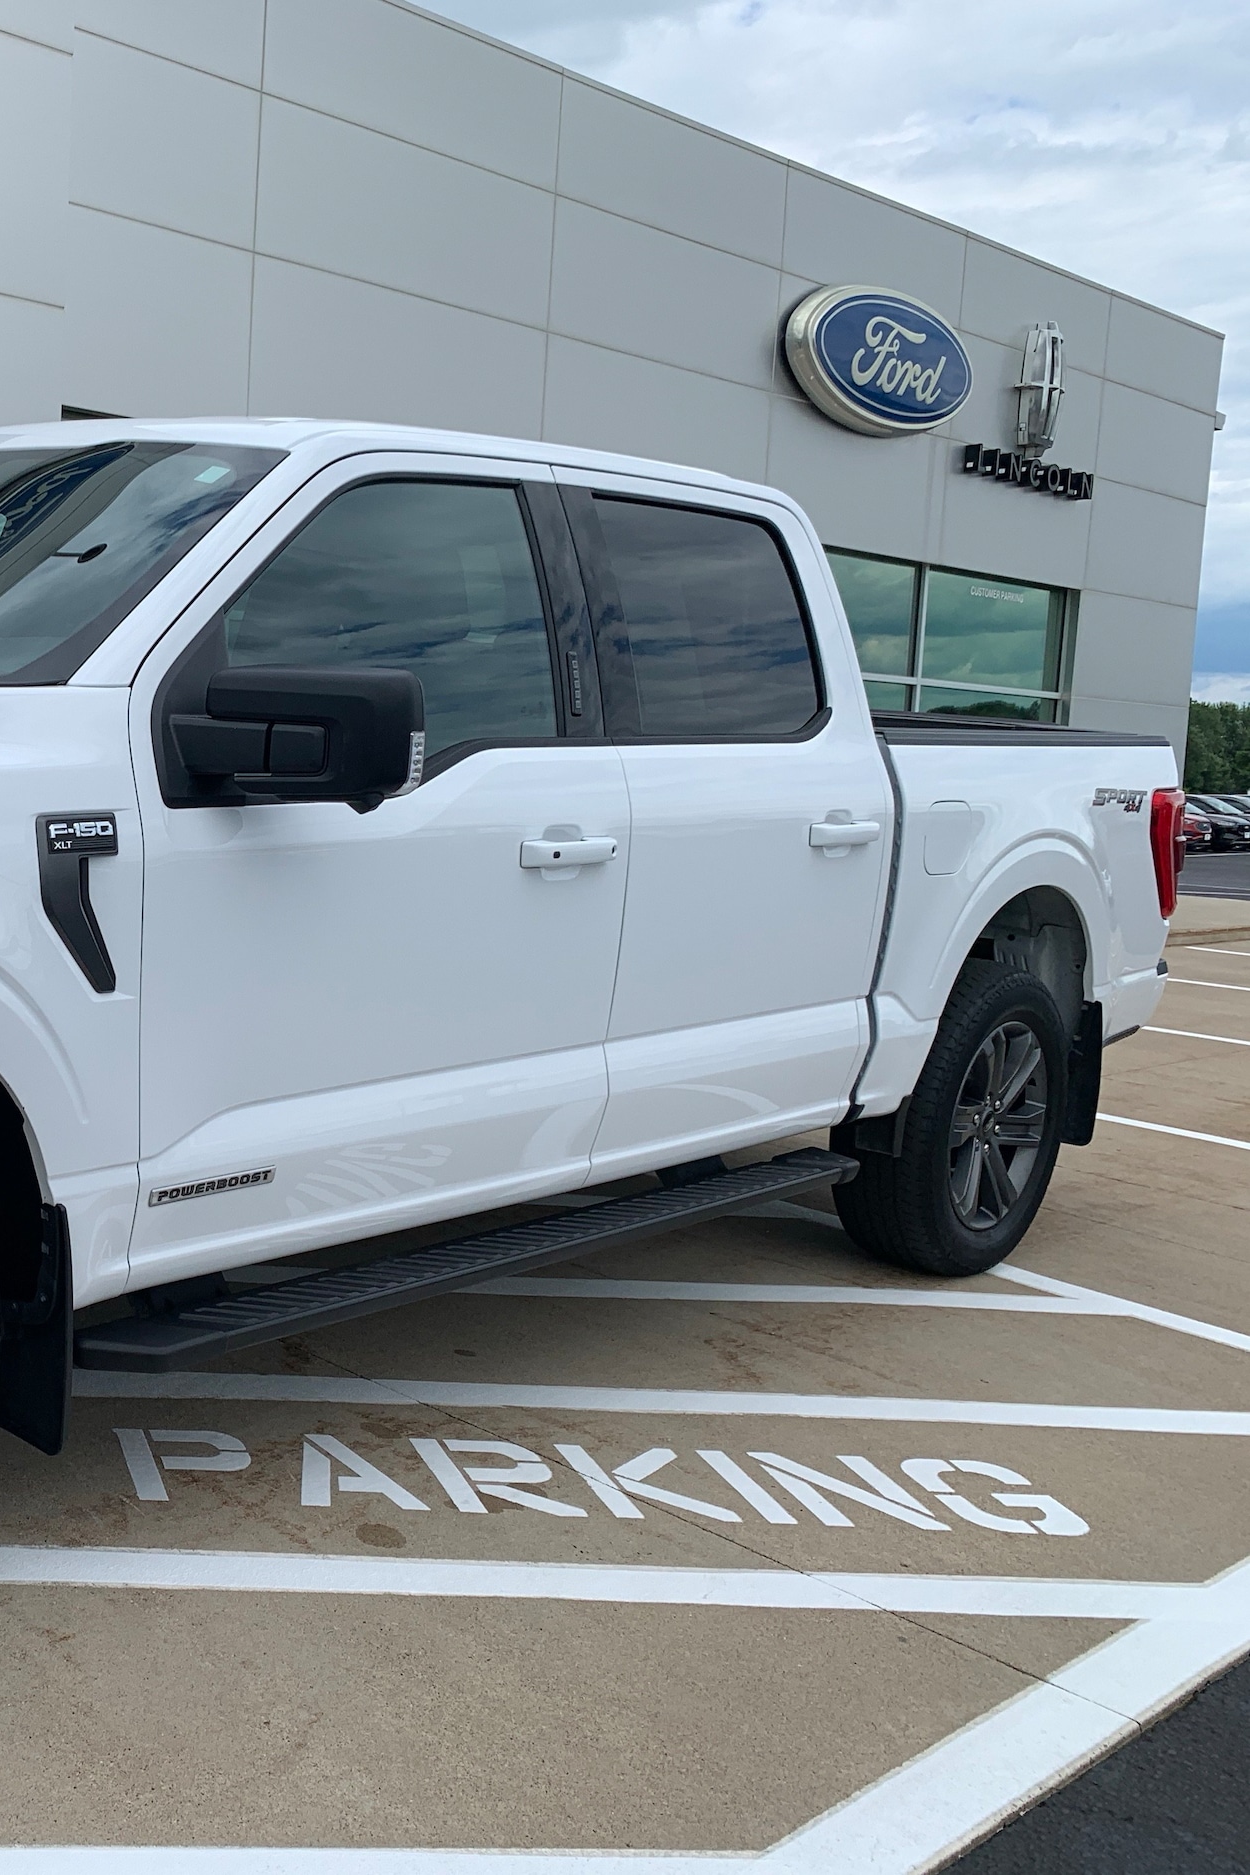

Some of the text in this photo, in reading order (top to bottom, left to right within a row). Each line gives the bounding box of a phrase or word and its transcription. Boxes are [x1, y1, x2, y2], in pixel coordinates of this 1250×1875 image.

[851, 315, 947, 405] Ford
[963, 443, 1094, 500] LINCOLN
[970, 586, 1024, 603] CUSTOMER PARKING
[1092, 787, 1148, 806] SPORT
[48, 820, 114, 839] F-150
[53, 840, 73, 850] XLT
[157, 1169, 272, 1202] POWERBOOST
[111, 1428, 1091, 1536] PARKING
